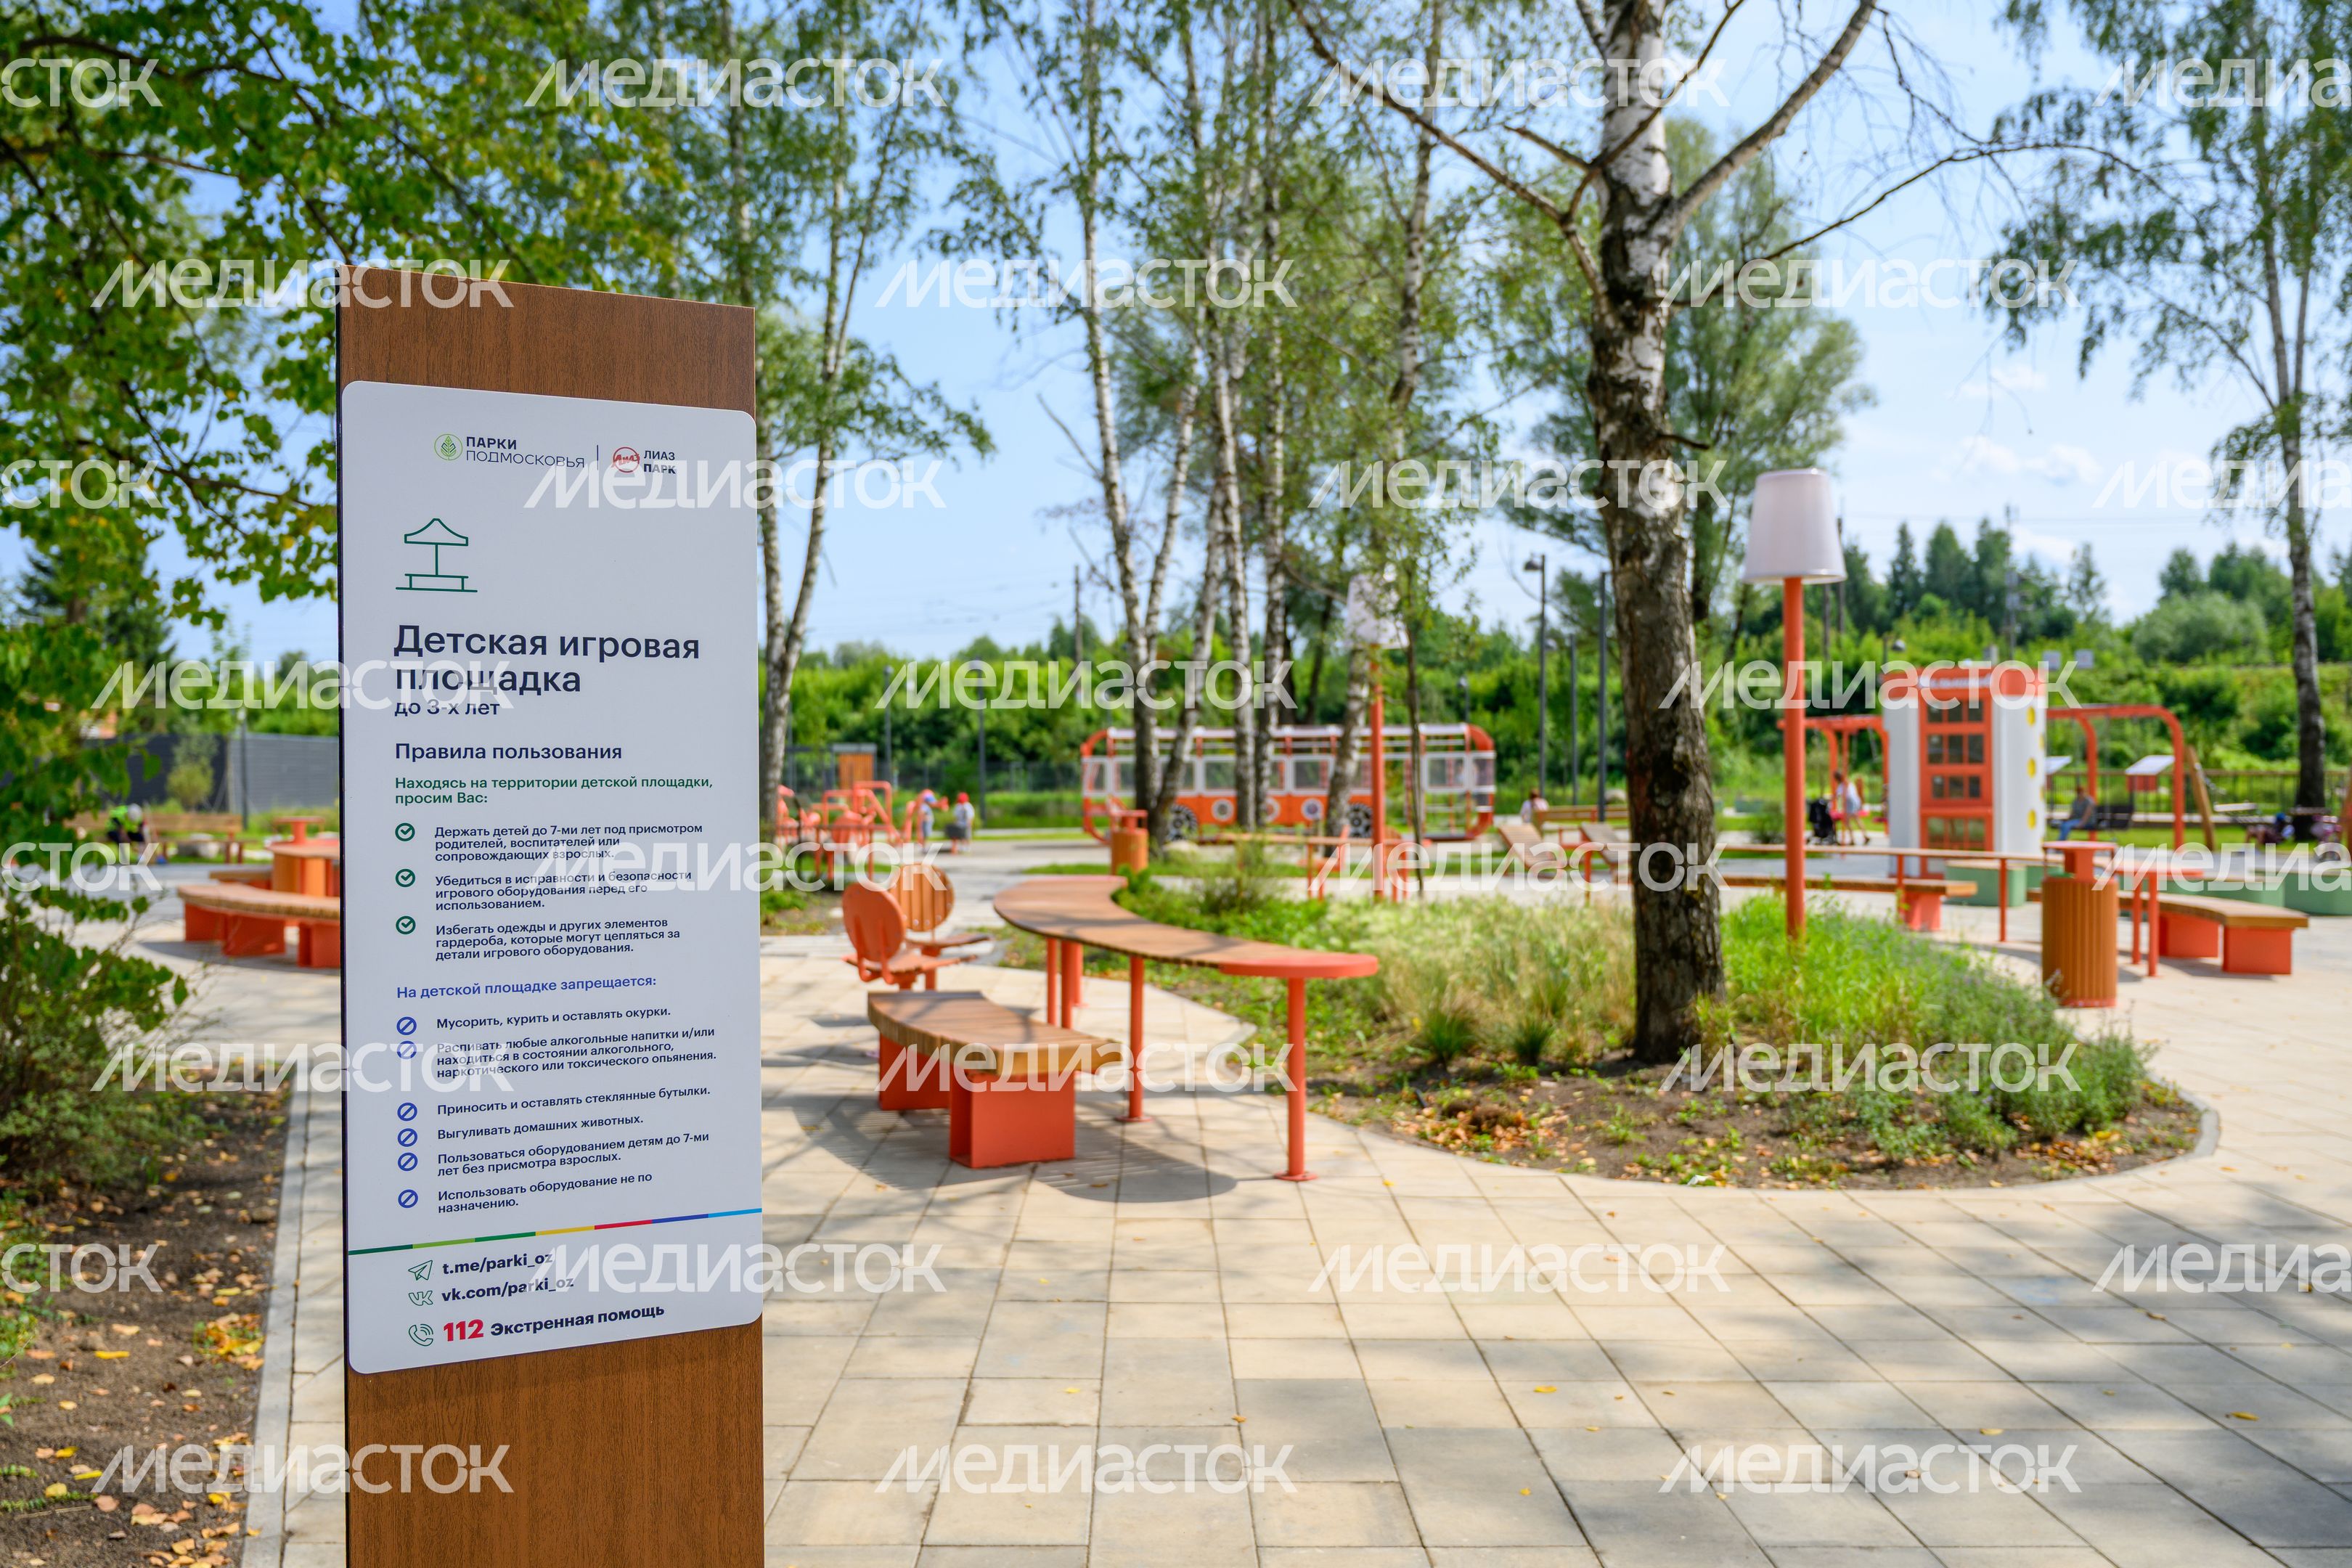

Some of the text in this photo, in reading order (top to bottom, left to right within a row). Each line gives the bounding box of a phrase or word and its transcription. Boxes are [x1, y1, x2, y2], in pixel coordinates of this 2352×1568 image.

[466, 436, 517, 449] ПАРКИ
[466, 451, 584, 467] ПОДМОСКОВЬЯ
[644, 451, 675, 460] ЛИАЗ
[644, 464, 676, 474] ПАРК
[394, 625, 699, 662] Детская игровая
[396, 669, 580, 695] площадка
[395, 699, 499, 716] до 3-х лет
[396, 743, 621, 762] Правила пользования
[396, 776, 713, 791] Находясь на территории детской площадки,
[396, 792, 488, 806] просим Вас:
[435, 824, 702, 840] Держать детей до 7-ми лет под присмотром
[436, 836, 620, 851] родителей, воспитателей или
[436, 849, 614, 862] сопровождающих взрослых.
[436, 870, 691, 888] Убедиться в исправности и безопасности
[436, 883, 647, 899] игрового оборудования перед его
[436, 899, 544, 911] использованием.
[436, 924, 494, 936] Избегать
[497, 923, 546, 935] одежды
[560, 921, 600, 932] других
[605, 918, 668, 929] элементов
[436, 930, 679, 949] гардероба, которые могут цепляться за
[436, 943, 633, 962] детали игрового оборудования.
[397, 976, 656, 999] На детской площадке запрещается:
[437, 1008, 670, 1029] Мусорить, курить и оставлять окурки.
[437, 1028, 714, 1053] Распивать любые алкогольные напитки и/или
[437, 1052, 510, 1065] находиться
[523, 1048, 587, 1060] состоянии
[591, 1042, 674, 1056] алкогольного,
[437, 1051, 716, 1078] наркотического или токсического опьянения.
[437, 1086, 710, 1116] Приносить и оставлять стеклянные бутылки.
[437, 1115, 643, 1140] Выгуливать домашних животных.
[438, 1132, 709, 1165] Пользоваться оборудованием детям до 7-ми
[437, 1153, 621, 1177] лет без присмотра взрослых.
[438, 1173, 653, 1201] Использовать оборудование не по
[438, 1199, 518, 1214] назначению.
[443, 1254, 552, 1275] t.me/parki_oz
[441, 1278, 574, 1302] vk.com/parki_oz
[443, 1306, 664, 1342] 112 Экстренная помощь
